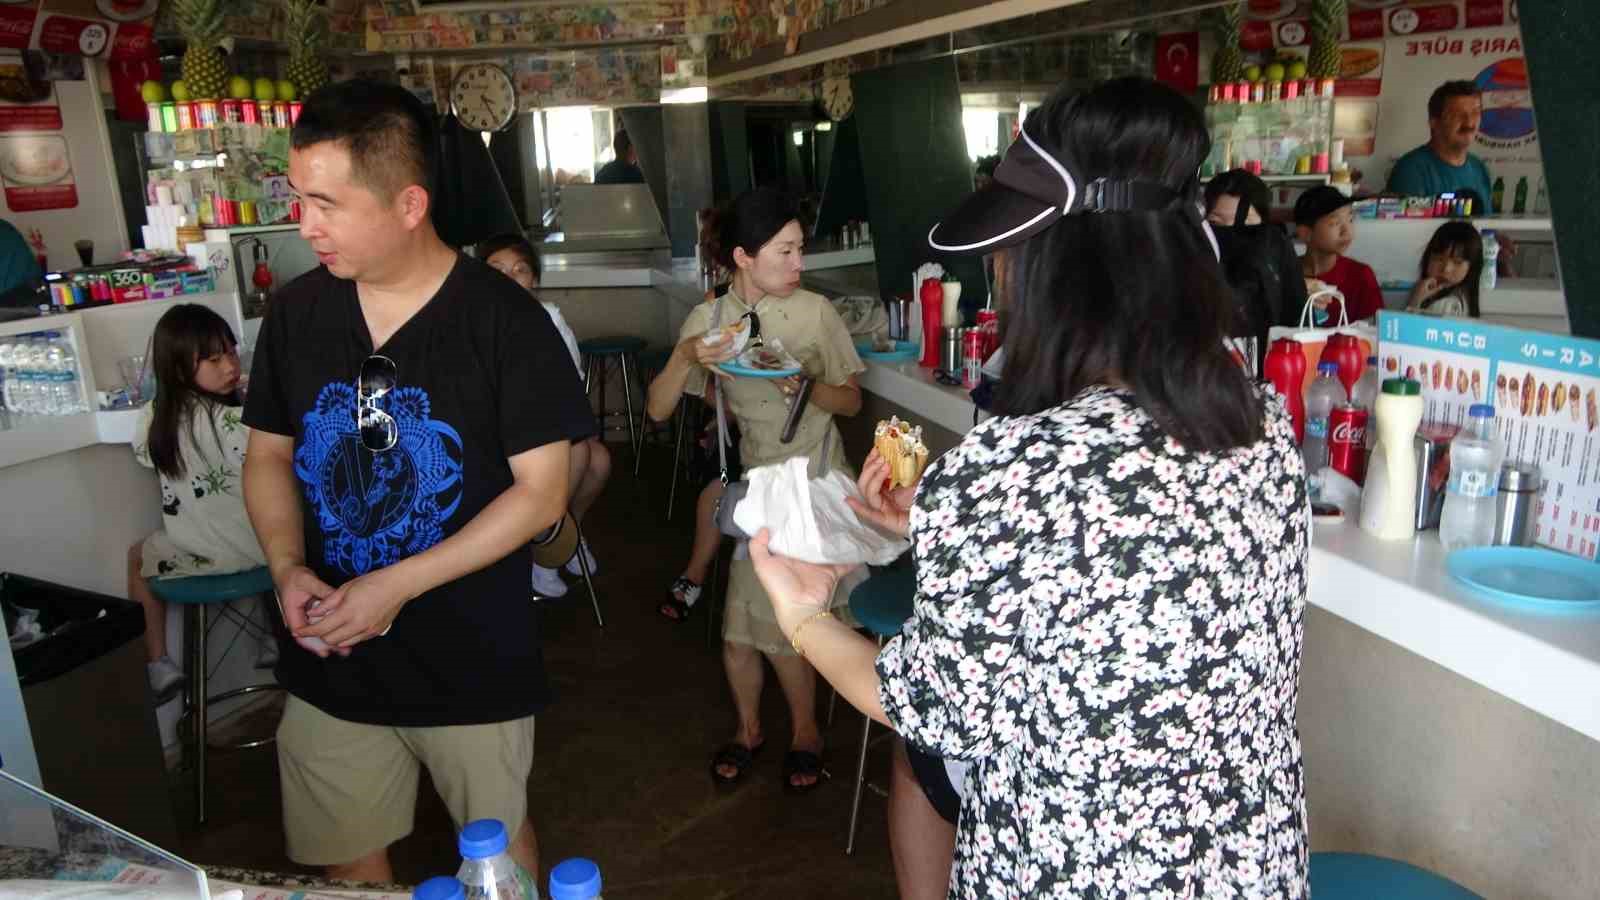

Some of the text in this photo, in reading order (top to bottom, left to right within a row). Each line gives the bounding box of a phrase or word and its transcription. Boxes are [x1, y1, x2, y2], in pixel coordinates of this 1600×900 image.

[112, 272, 141, 287] 360
[1520, 342, 1600, 368] ARIŞ
[1333, 421, 1362, 443] Coca
